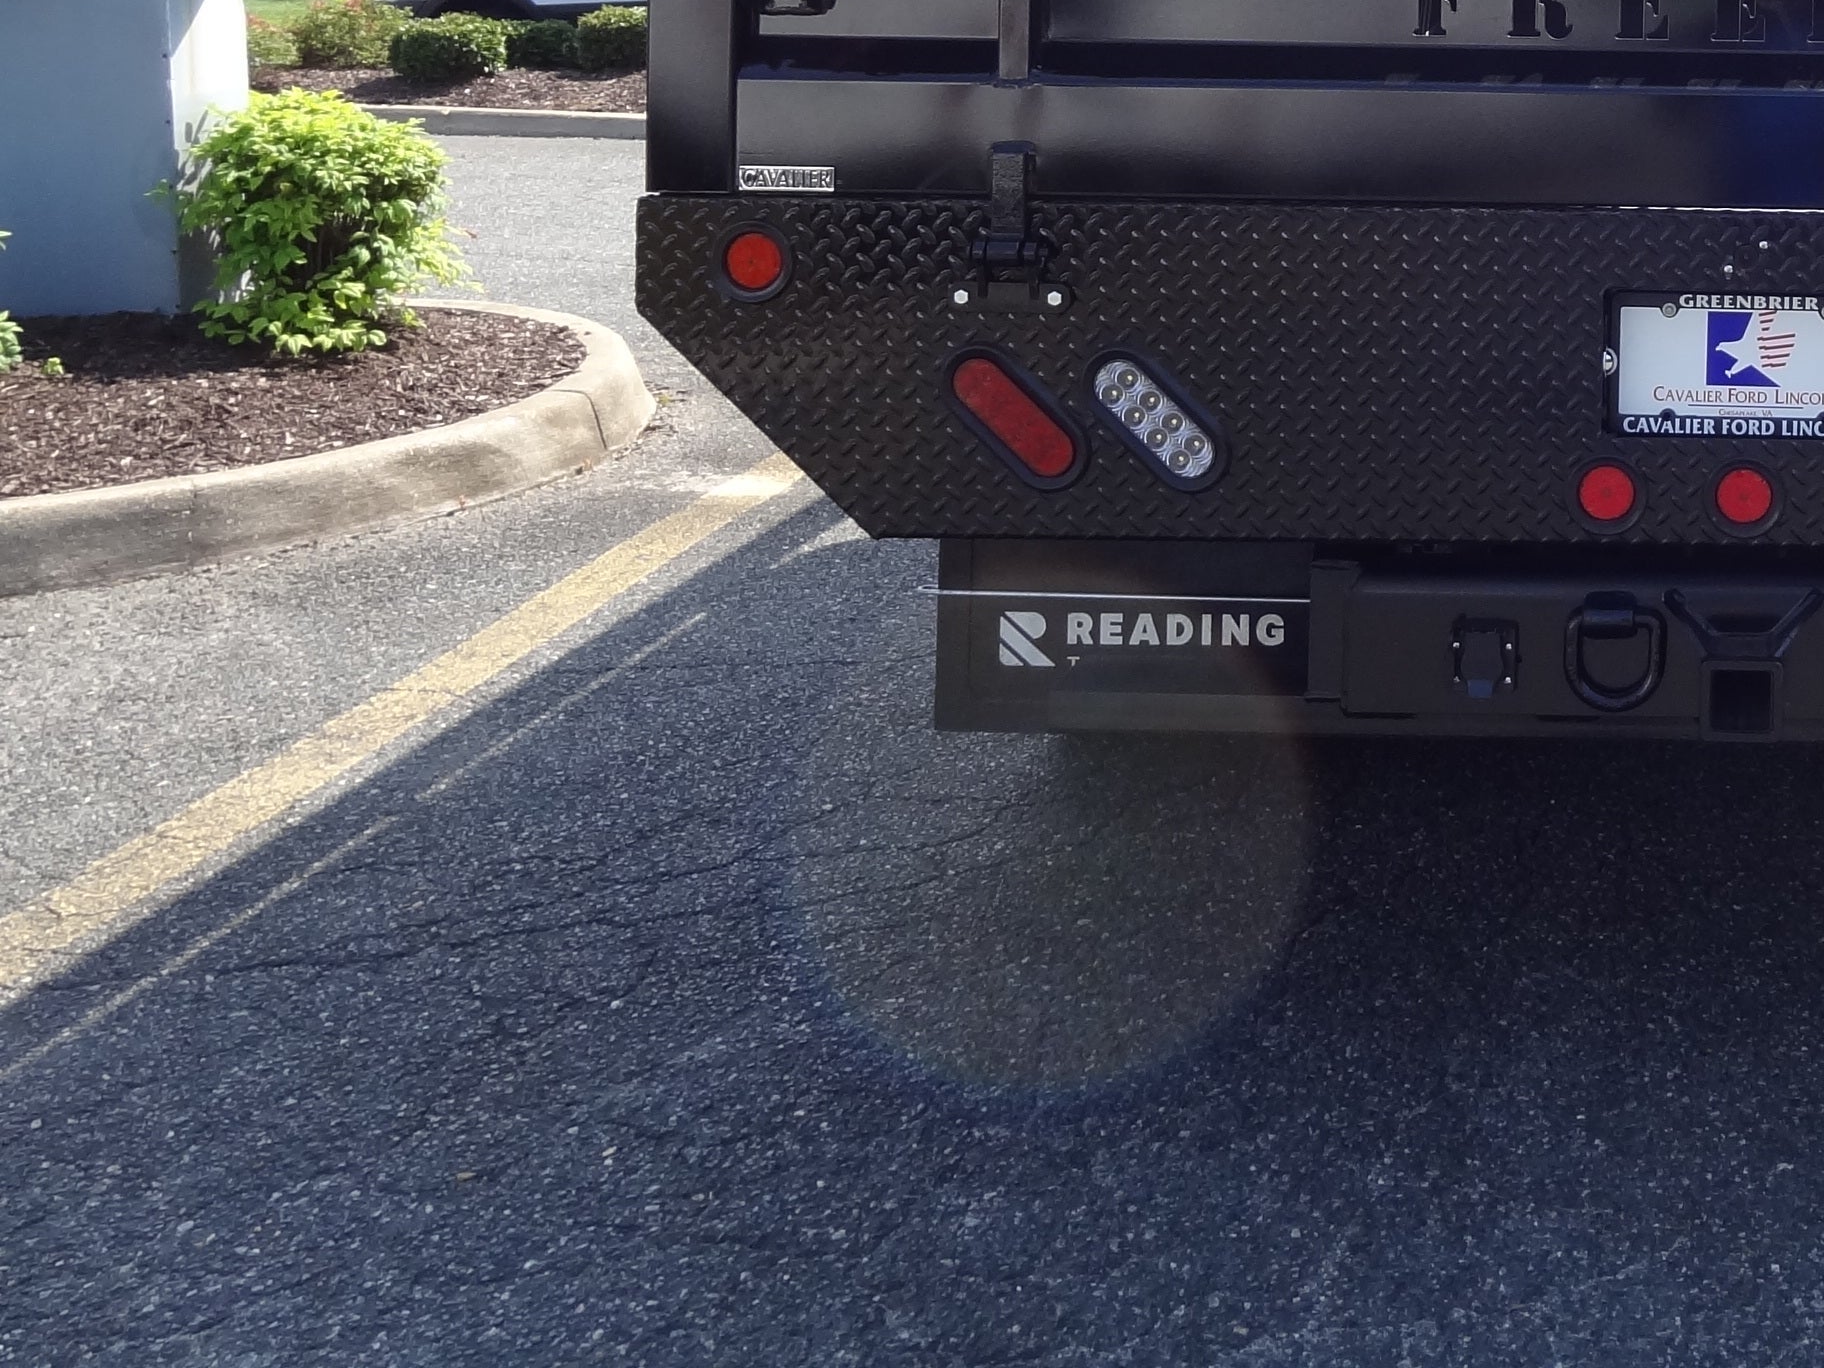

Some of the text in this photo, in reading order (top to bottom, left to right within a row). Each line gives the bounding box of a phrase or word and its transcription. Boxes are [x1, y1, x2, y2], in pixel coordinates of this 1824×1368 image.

[1678, 294, 1819, 311] GREENBRIER
[1653, 385, 1723, 403] CAVALIER
[1727, 387, 1768, 405] FORD
[1622, 416, 1715, 435] CAVALIER
[1722, 418, 1775, 436] FORD
[1067, 612, 1286, 646] READING
